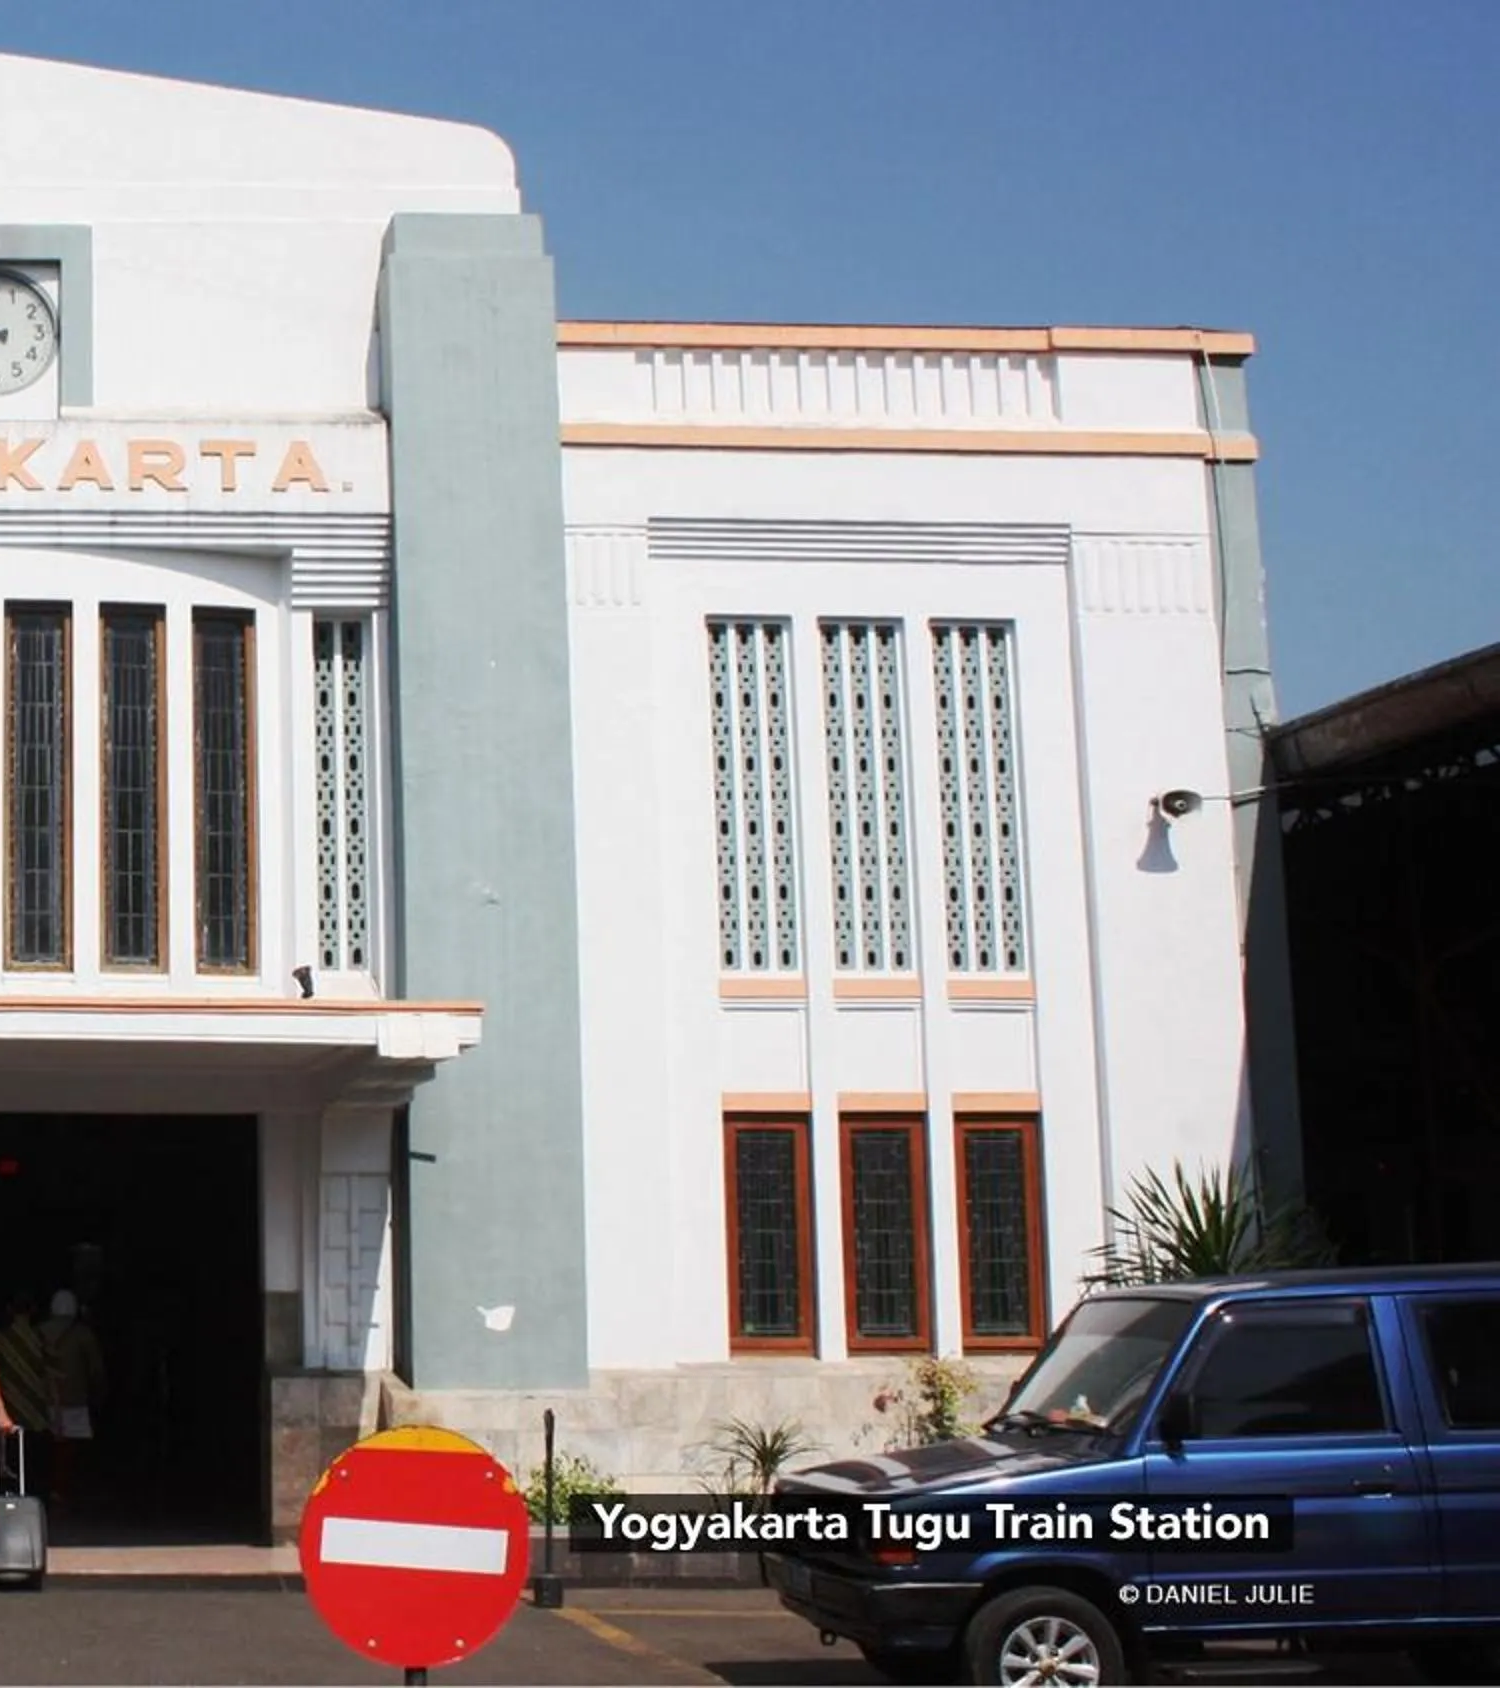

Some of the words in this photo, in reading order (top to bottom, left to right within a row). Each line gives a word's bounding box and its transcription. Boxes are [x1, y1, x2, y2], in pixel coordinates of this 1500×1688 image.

[26, 303, 37, 320] 2
[34, 324, 45, 341] 3
[25, 346, 37, 361] 4
[11, 362, 23, 378] 5
